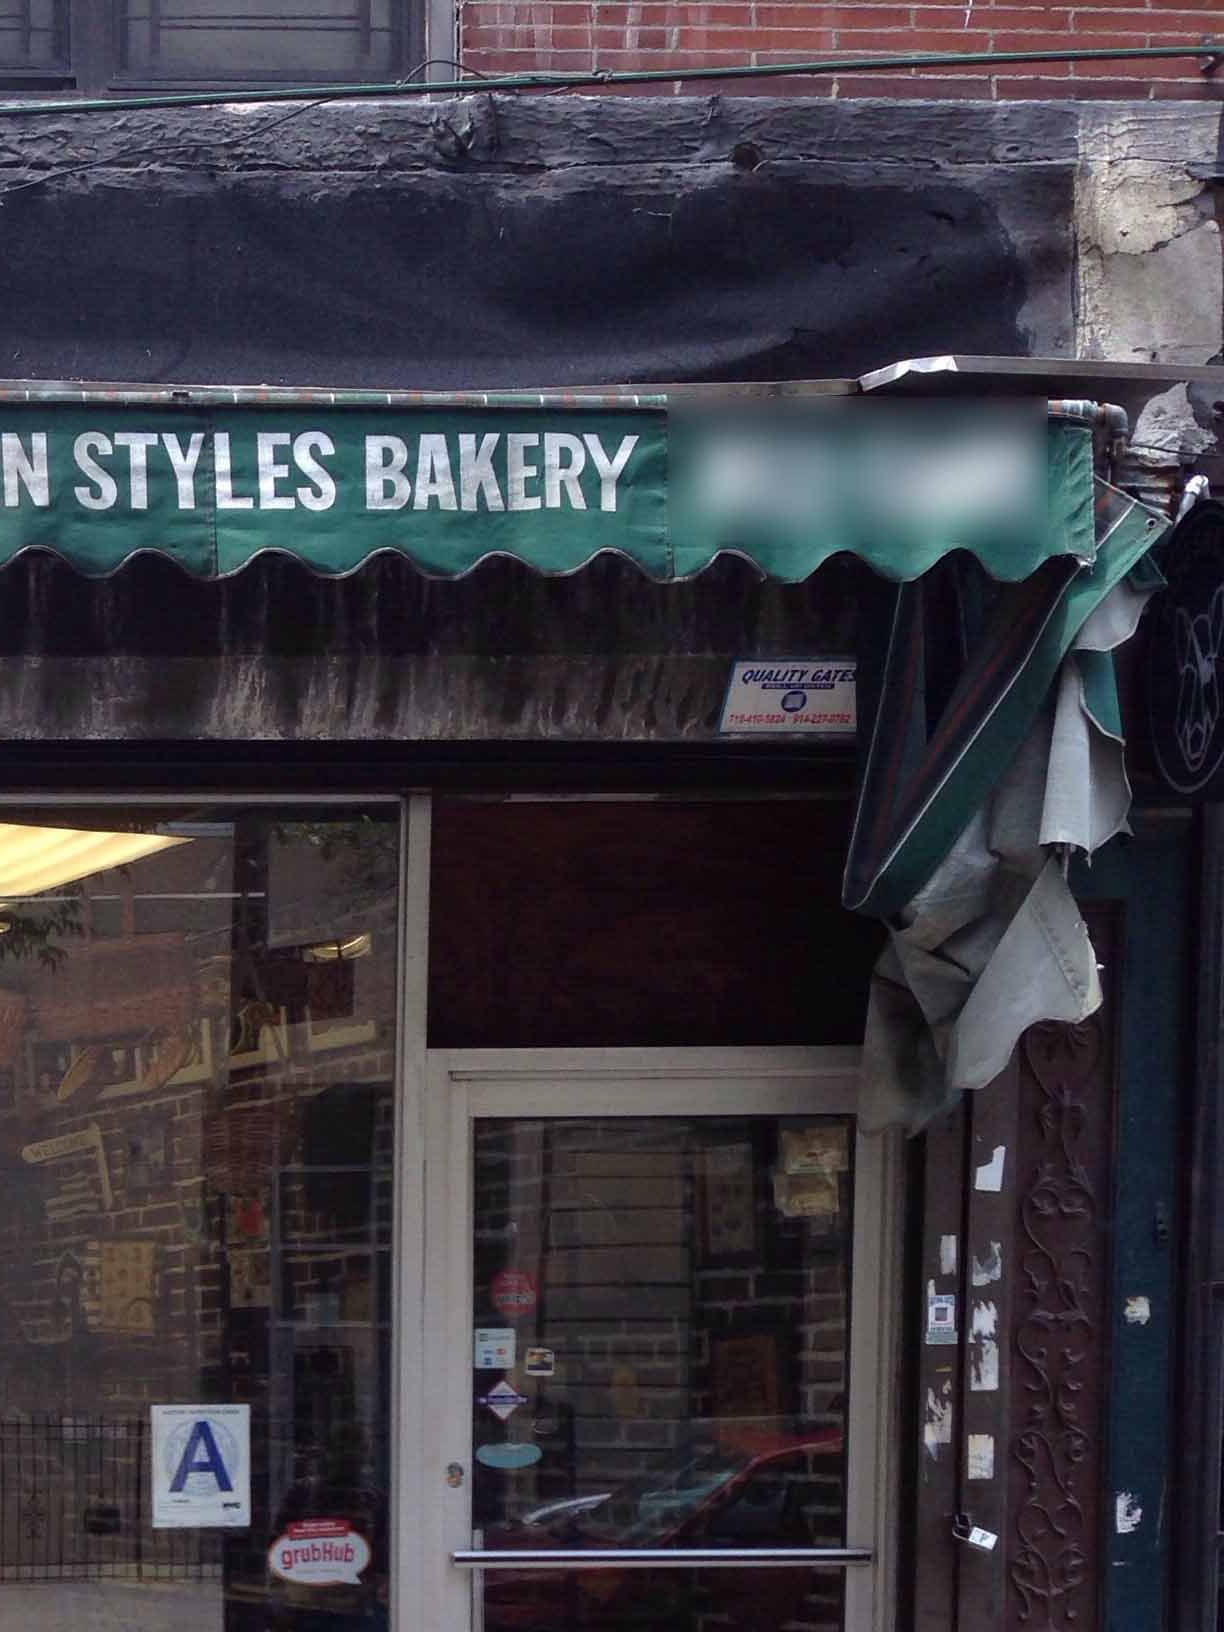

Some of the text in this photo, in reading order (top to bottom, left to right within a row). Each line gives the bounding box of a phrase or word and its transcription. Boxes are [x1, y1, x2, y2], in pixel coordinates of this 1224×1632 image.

[74, 431, 336, 511] STYLES
[365, 432, 640, 512] BAKERY
[742, 669, 857, 684] QUALITY GATES
[169, 1421, 234, 1492] A
[281, 1541, 355, 1570] grubHub
